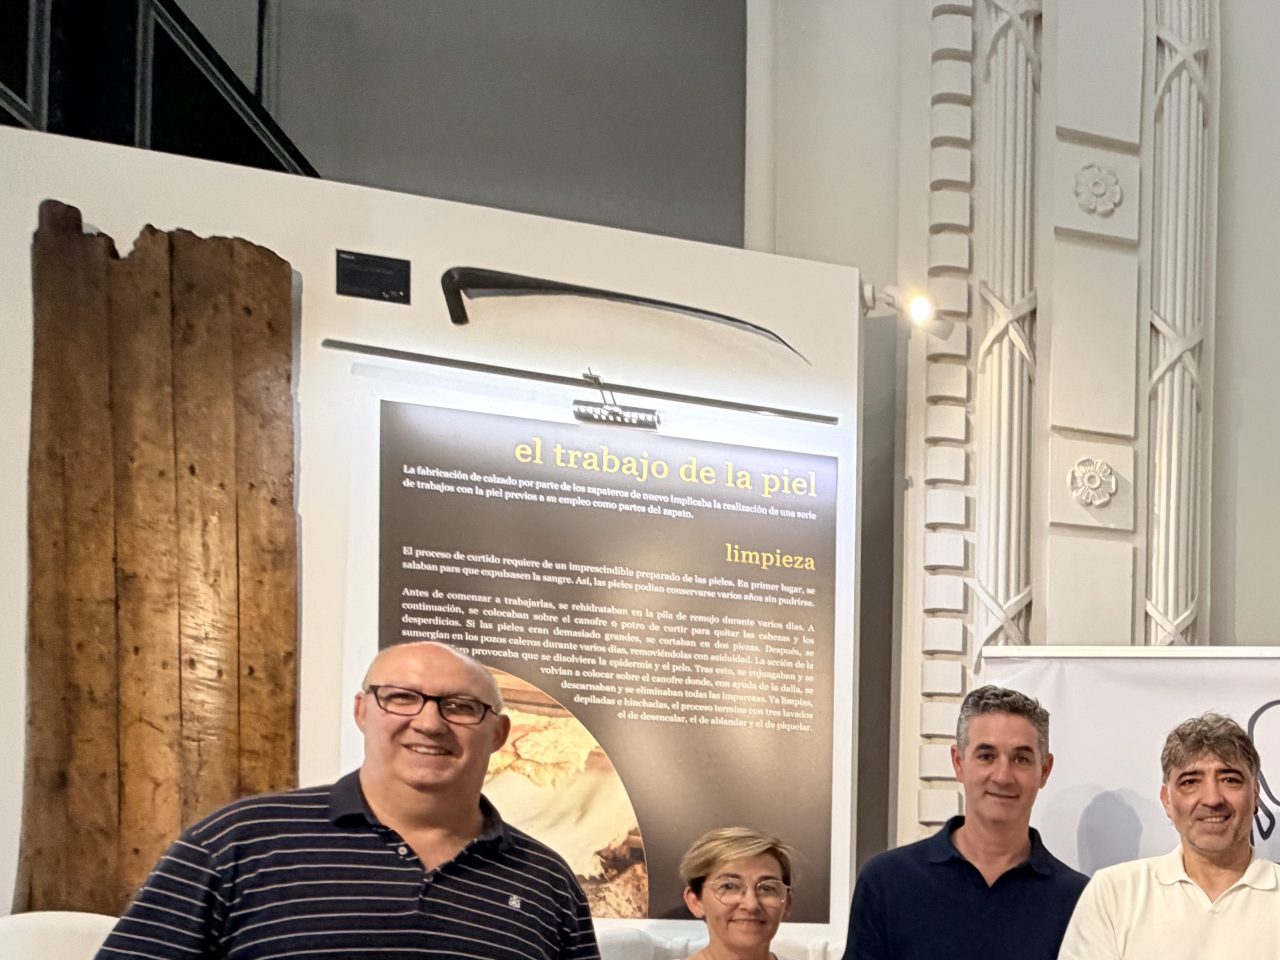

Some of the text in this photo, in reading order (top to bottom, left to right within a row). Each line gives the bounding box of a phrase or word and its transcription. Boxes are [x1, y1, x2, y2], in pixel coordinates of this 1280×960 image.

[515, 438, 816, 497] el trabajo de la piel
[403, 464, 816, 520] La fabricación de calzado por parte de los zapateros de nuevo implicaba la realización de una serie
[403, 478, 415, 488] de
[417, 479, 454, 493] trabajos
[457, 486, 473, 494] con
[476, 485, 484, 495] la
[486, 487, 503, 498] piel
[505, 490, 537, 501] previos
[547, 495, 556, 503] su
[559, 496, 591, 507] empleo
[593, 500, 617, 509] como
[619, 502, 645, 512] partes
[647, 504, 661, 514] del
[663, 508, 694, 518] zapato.
[403, 546, 413, 556] El
[415, 550, 451, 559] proceso
[454, 551, 465, 560] de
[467, 553, 500, 563] curtido
[503, 556, 540, 567] requiere
[542, 558, 553, 568] de
[569, 561, 634, 576] imprescindible
[636, 570, 680, 581] preparado
[683, 573, 693, 583] de
[695, 574, 706, 584] las
[709, 576, 735, 587] pieles.
[738, 578, 749, 588] En
[751, 580, 779, 591] primer
[781, 582, 804, 594] lugar,
[725, 543, 815, 570] limpieza
[402, 561, 815, 607] salaban para que expulsasen la sangre. Así, las pieles podían conservarse varios años sin pudrirse.
